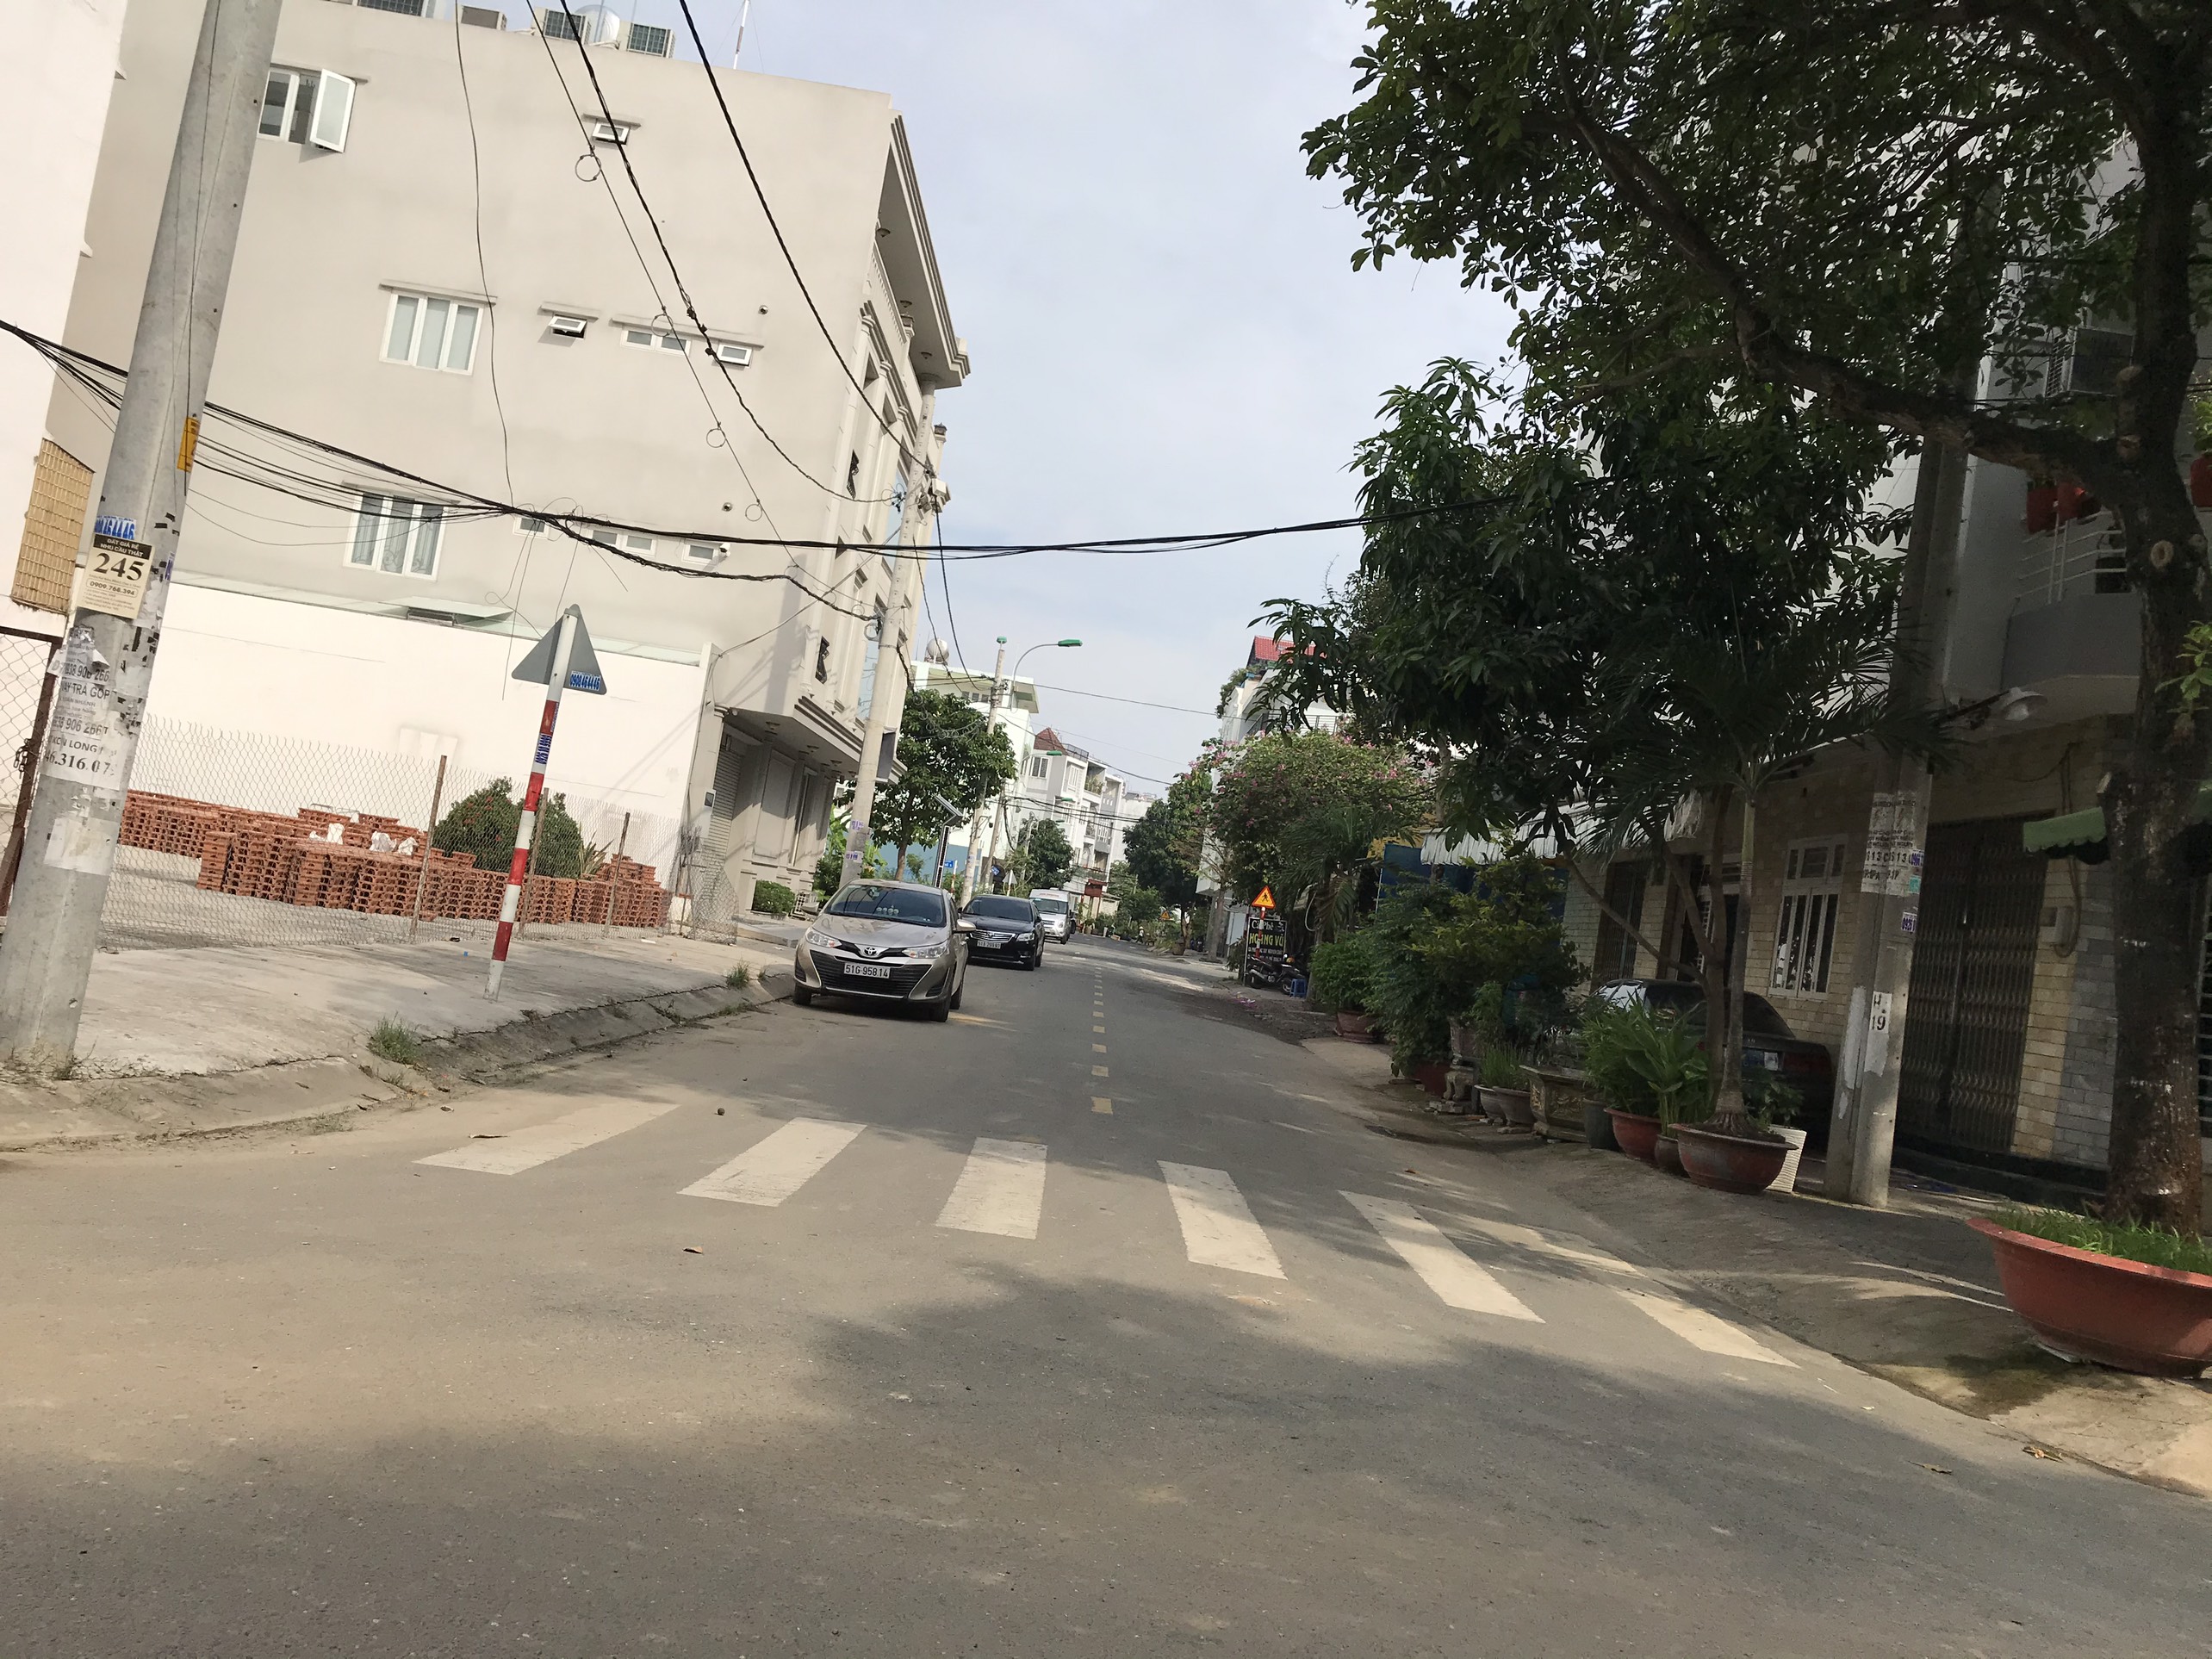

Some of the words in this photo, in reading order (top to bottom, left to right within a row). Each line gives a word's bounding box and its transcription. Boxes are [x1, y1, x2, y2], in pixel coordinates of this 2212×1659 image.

[93, 552, 145, 581] 245
[90, 581, 135, 596] 0909.768.394
[94, 668, 110, 682] 266
[69, 740, 97, 753] LONG
